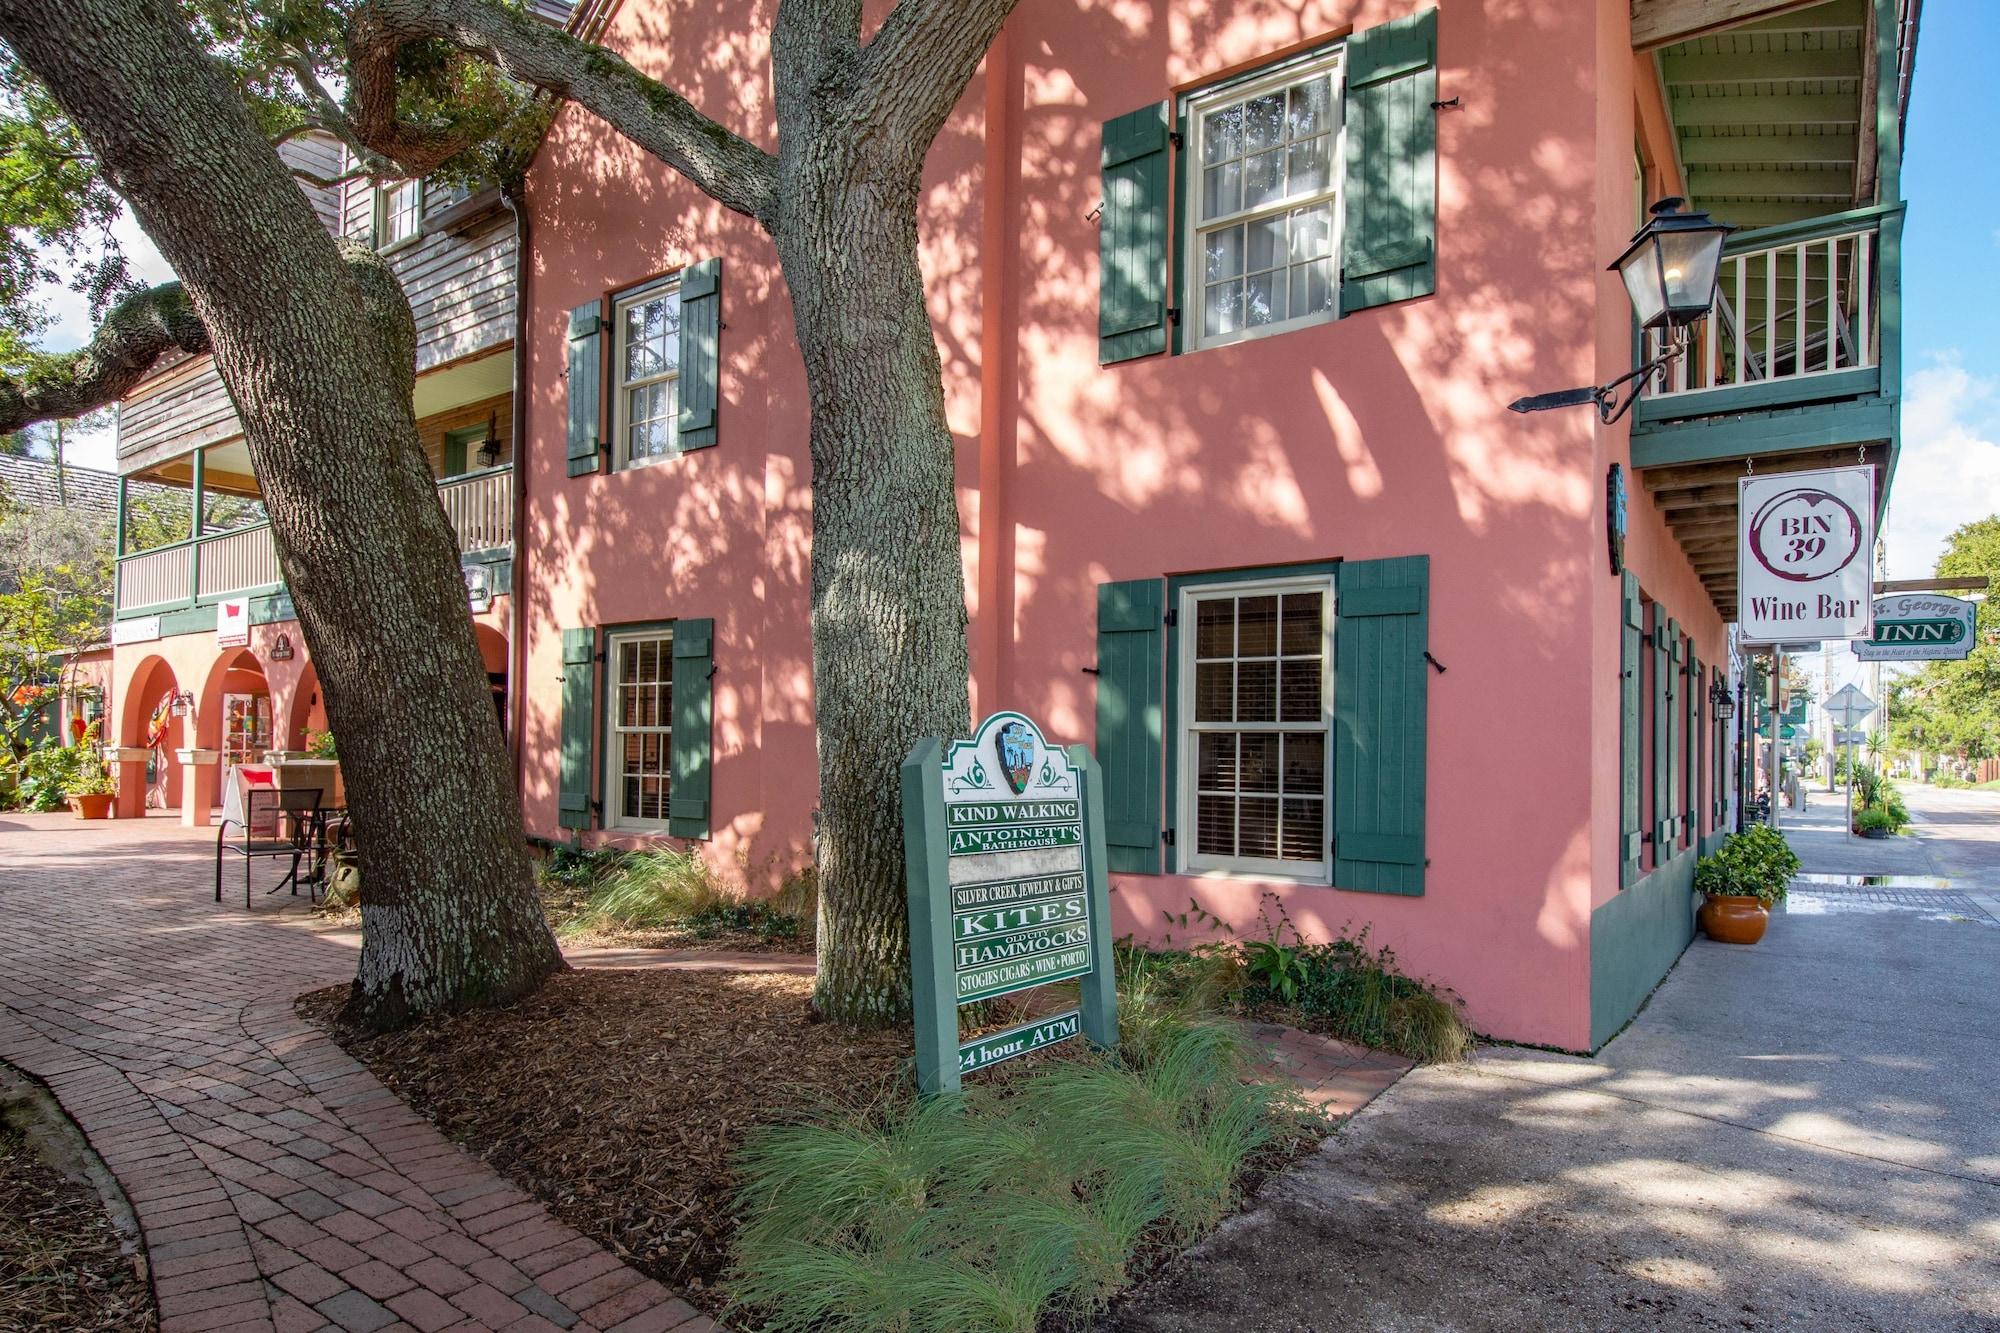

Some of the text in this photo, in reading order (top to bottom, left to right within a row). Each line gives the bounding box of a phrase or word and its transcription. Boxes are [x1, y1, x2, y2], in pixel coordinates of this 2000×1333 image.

[1781, 514, 1833, 537] BIN
[1784, 536, 1826, 563] 39
[1751, 594, 1860, 623] Wine Bar
[1898, 598, 1961, 617] George
[277, 636, 285, 651] 4
[1878, 624, 1948, 641] INN
[1863, 648, 1875, 657] Stay
[1882, 648, 1890, 656] the
[1891, 648, 1905, 656] Heart
[1906, 648, 1912, 657] of
[1913, 648, 1921, 656] the
[1922, 648, 1941, 656] Historic
[1943, 647, 1963, 656] District
[952, 803, 1076, 822] KIND WALKING
[952, 825, 1081, 850] ANTOINETT'S
[982, 837, 1058, 851] BATH HOUSE
[957, 876, 1083, 906] SILVER CREEK JEWELRY & GIFTS
[961, 899, 1082, 936] KITES
[959, 925, 1087, 966] HAMMOCKS
[1005, 929, 1050, 944] OLD CITY
[961, 950, 1086, 992] STOGIES CIGARS WINE PORTO
[979, 1039, 1024, 1063] hour
[1030, 1017, 1078, 1046] ATM
